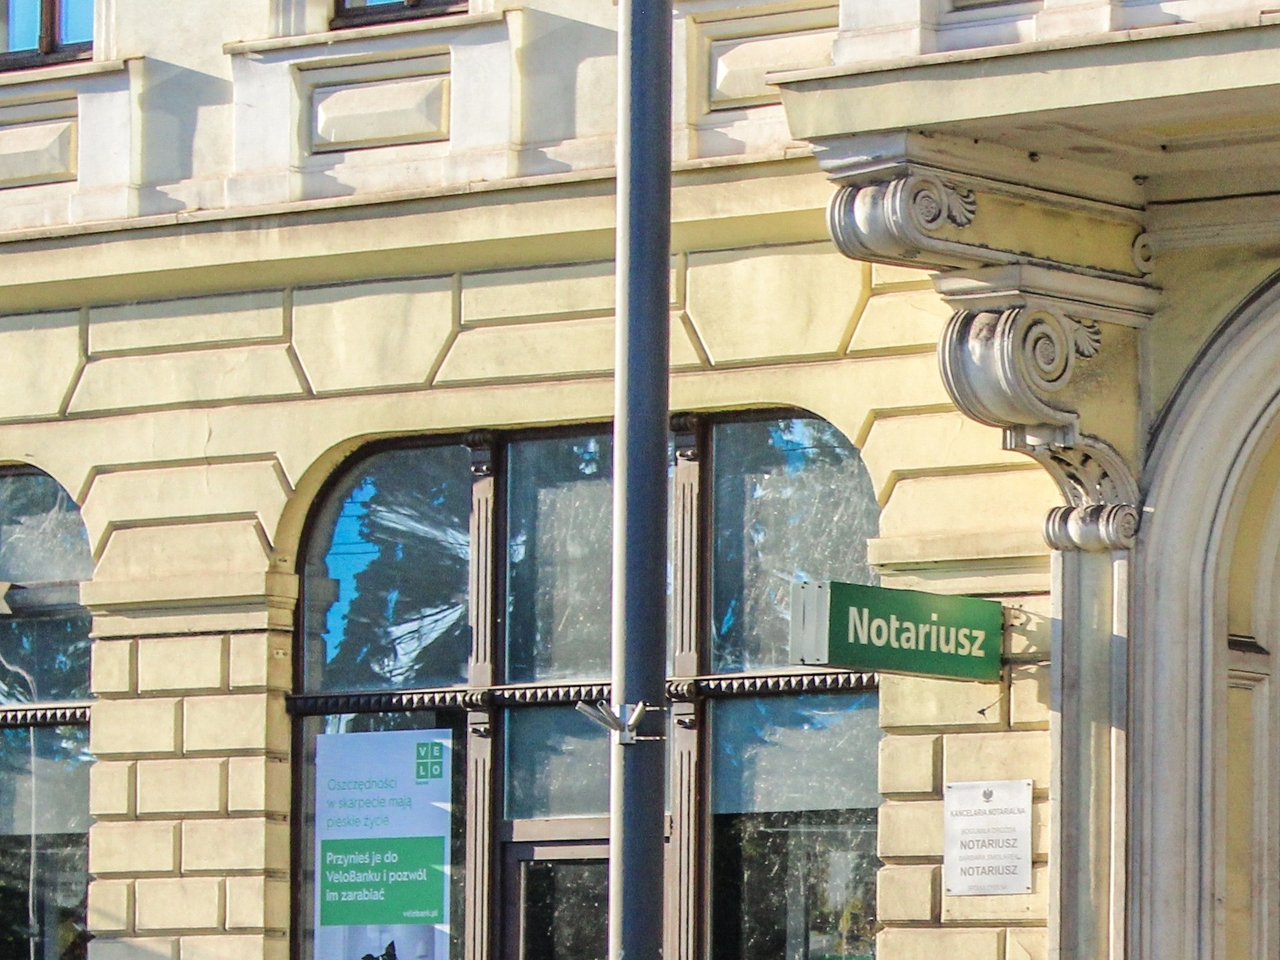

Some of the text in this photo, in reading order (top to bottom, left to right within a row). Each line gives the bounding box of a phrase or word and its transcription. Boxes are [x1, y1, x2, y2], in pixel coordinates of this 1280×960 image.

[848, 606, 986, 657] Notariusz
[327, 778, 397, 791] Oszczędności
[339, 796, 386, 809] skarpecie
[950, 807, 1026, 817] KANCELARIA NOTARIALNA
[327, 815, 389, 829] pieskie życie
[960, 838, 1018, 850] NOTARIUSZ
[326, 851, 398, 867] Przynieś je do
[326, 870, 381, 882] VeloBanku
[389, 869, 427, 884] pozwól
[960, 865, 1018, 877] NOTARIUSZ
[326, 888, 385, 901] im zarabiać
